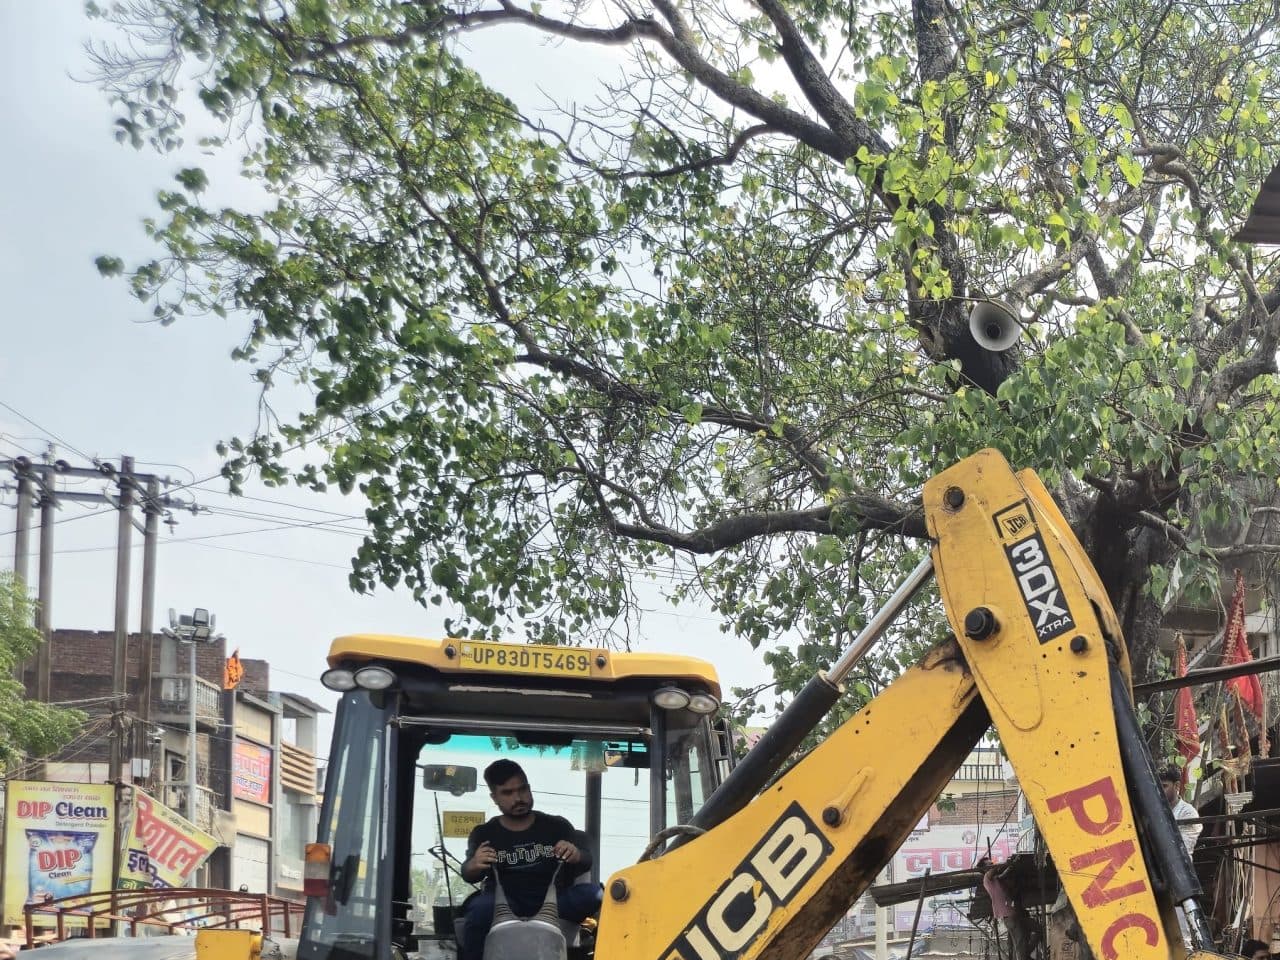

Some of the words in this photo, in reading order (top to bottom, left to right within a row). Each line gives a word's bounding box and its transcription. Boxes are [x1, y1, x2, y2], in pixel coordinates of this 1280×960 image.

[1006, 513, 1027, 534] JCB
[1011, 538, 1068, 628] 3DX
[1037, 615, 1072, 638] XTRA
[473, 647, 588, 672] UP83DT5469
[17, 800, 53, 819] DIP
[55, 801, 108, 819] Clean
[37, 848, 82, 872] DIP
